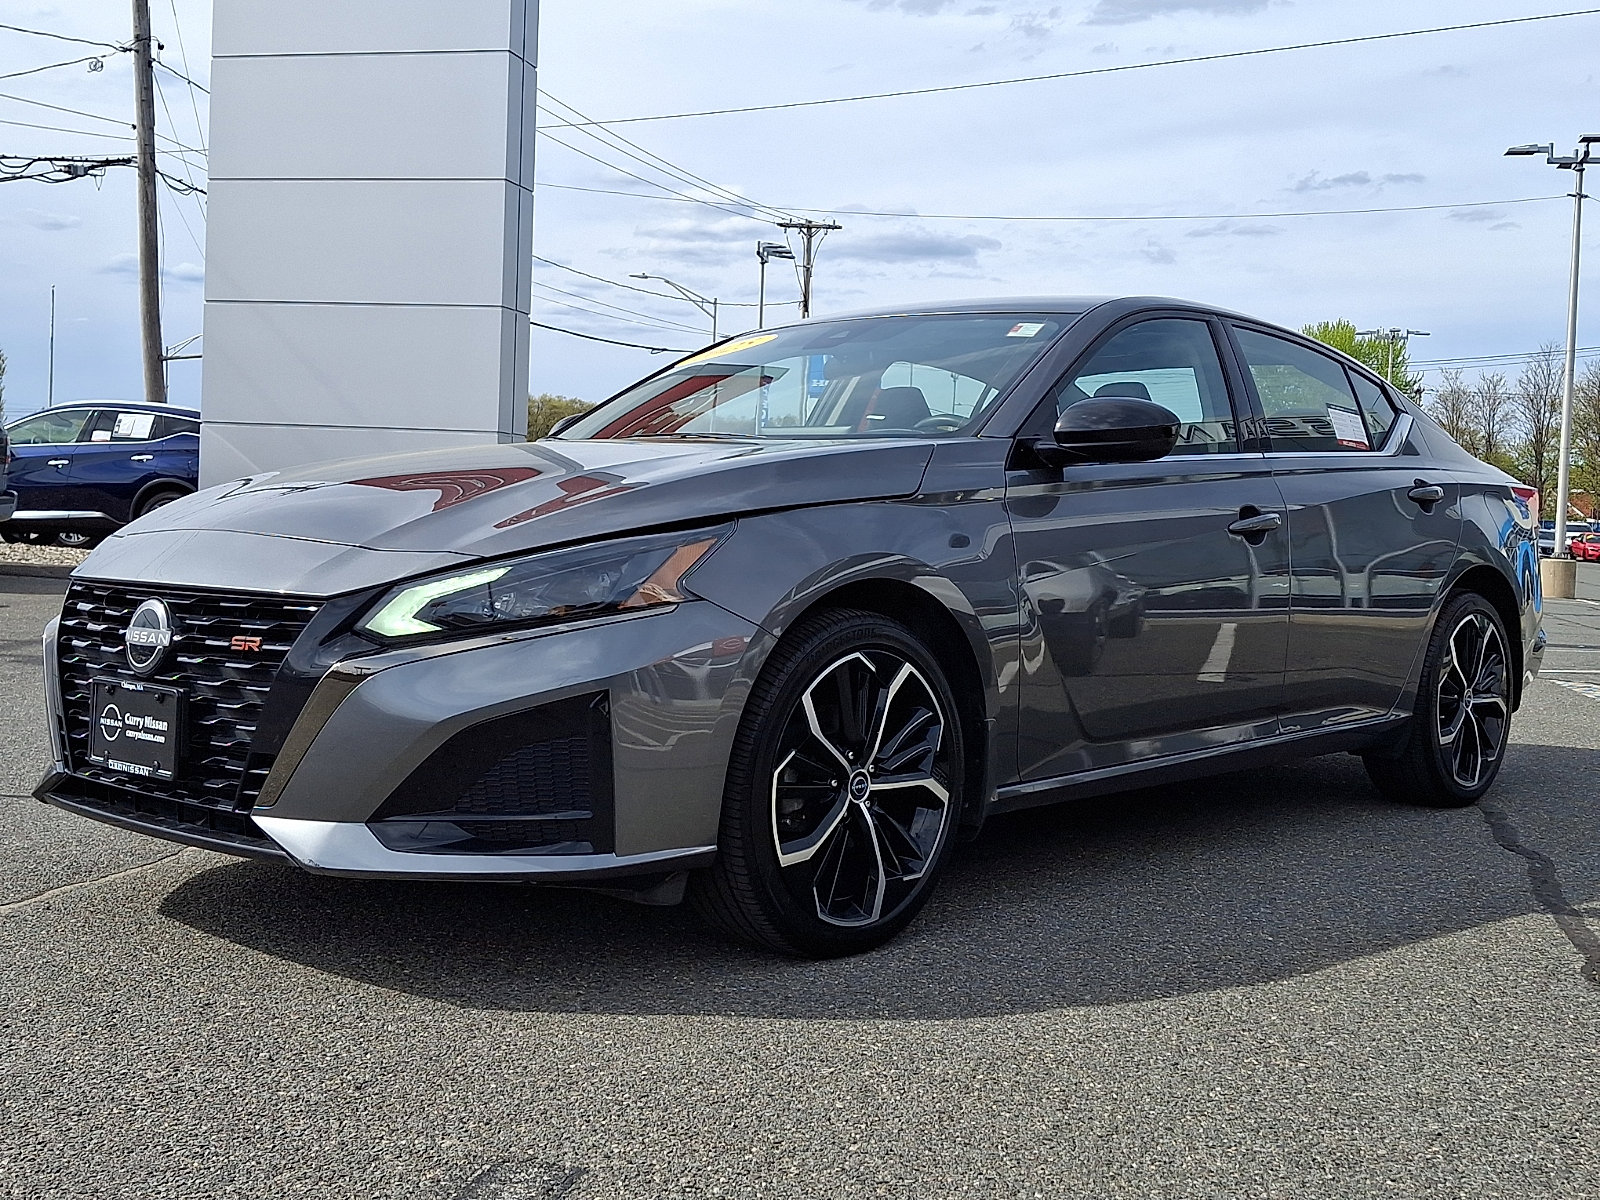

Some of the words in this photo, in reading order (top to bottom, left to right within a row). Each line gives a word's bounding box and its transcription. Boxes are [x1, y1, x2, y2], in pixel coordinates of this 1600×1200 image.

[126, 629, 169, 646] NISSAN
[230, 635, 262, 651] SR
[100, 716, 123, 728] NISSAN
[124, 712, 144, 730] Curry
[144, 715, 168, 731] Nissan
